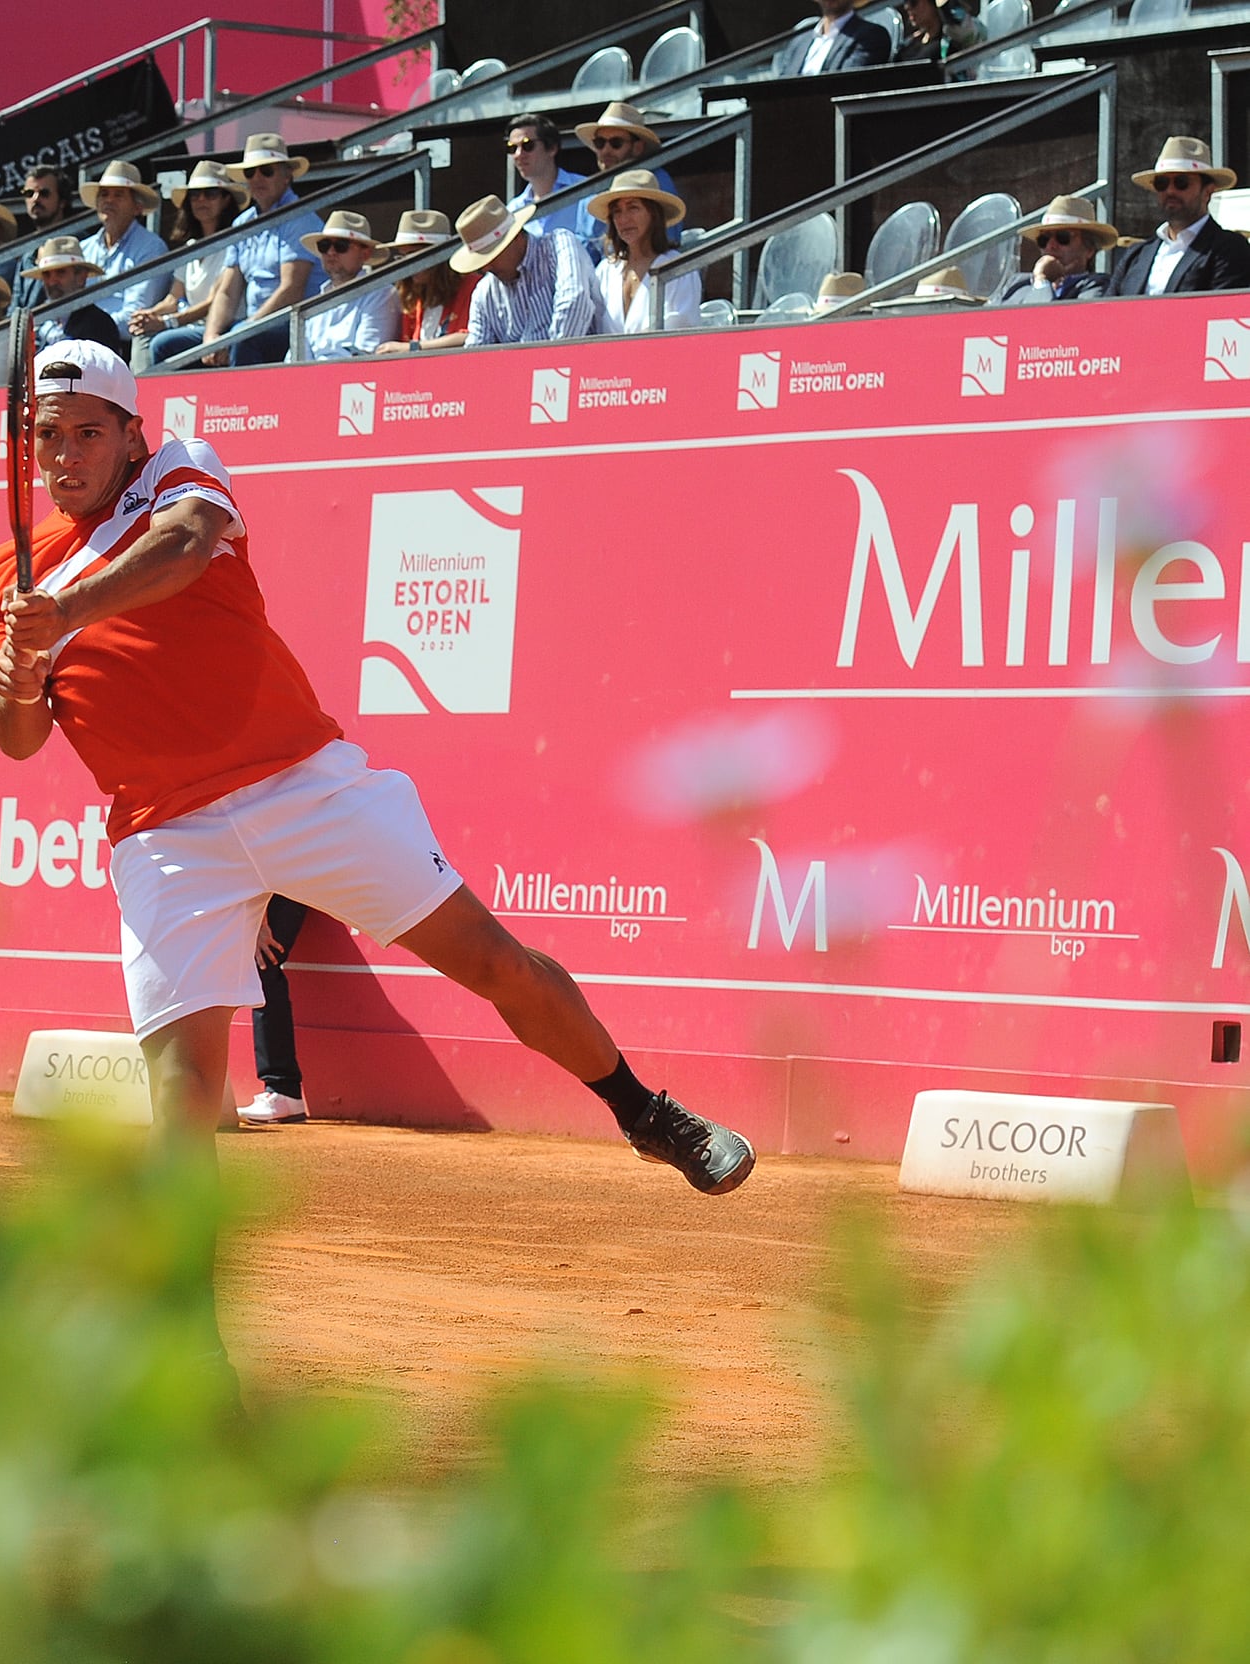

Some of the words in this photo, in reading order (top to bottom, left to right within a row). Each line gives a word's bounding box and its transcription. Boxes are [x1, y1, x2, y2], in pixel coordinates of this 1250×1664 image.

[1018, 345, 1079, 360] Millennium
[790, 361, 846, 375] Millennium
[1017, 360, 1076, 380] ESTORIL
[1078, 356, 1120, 376] OPEN
[579, 376, 632, 390] Millennium
[789, 375, 844, 393] ESTORIL
[845, 372, 885, 390] OPEN
[384, 390, 433, 404] Millennium
[578, 390, 629, 408] ESTORIL
[630, 388, 666, 405] OPEN
[204, 404, 249, 416] Millennium
[382, 404, 430, 421] ESTORIL
[431, 401, 465, 417] OPEN
[203, 417, 247, 433] ESTORIL
[247, 414, 279, 431] OPEN
[400, 551, 486, 573] Millennium
[394, 578, 490, 606] ESTORIL
[406, 609, 471, 635] OPEN
[420, 641, 454, 651] 2022
[493, 864, 666, 914] Millennium
[747, 838, 828, 952] M
[913, 873, 1115, 930] Millennium
[610, 919, 641, 943] bcp
[1050, 933, 1085, 961] bcp
[44, 1053, 146, 1085] SACOOR
[62, 1088, 118, 1106] brothers
[940, 1118, 1087, 1158] SACOOR
[970, 1160, 1047, 1184] brothers
